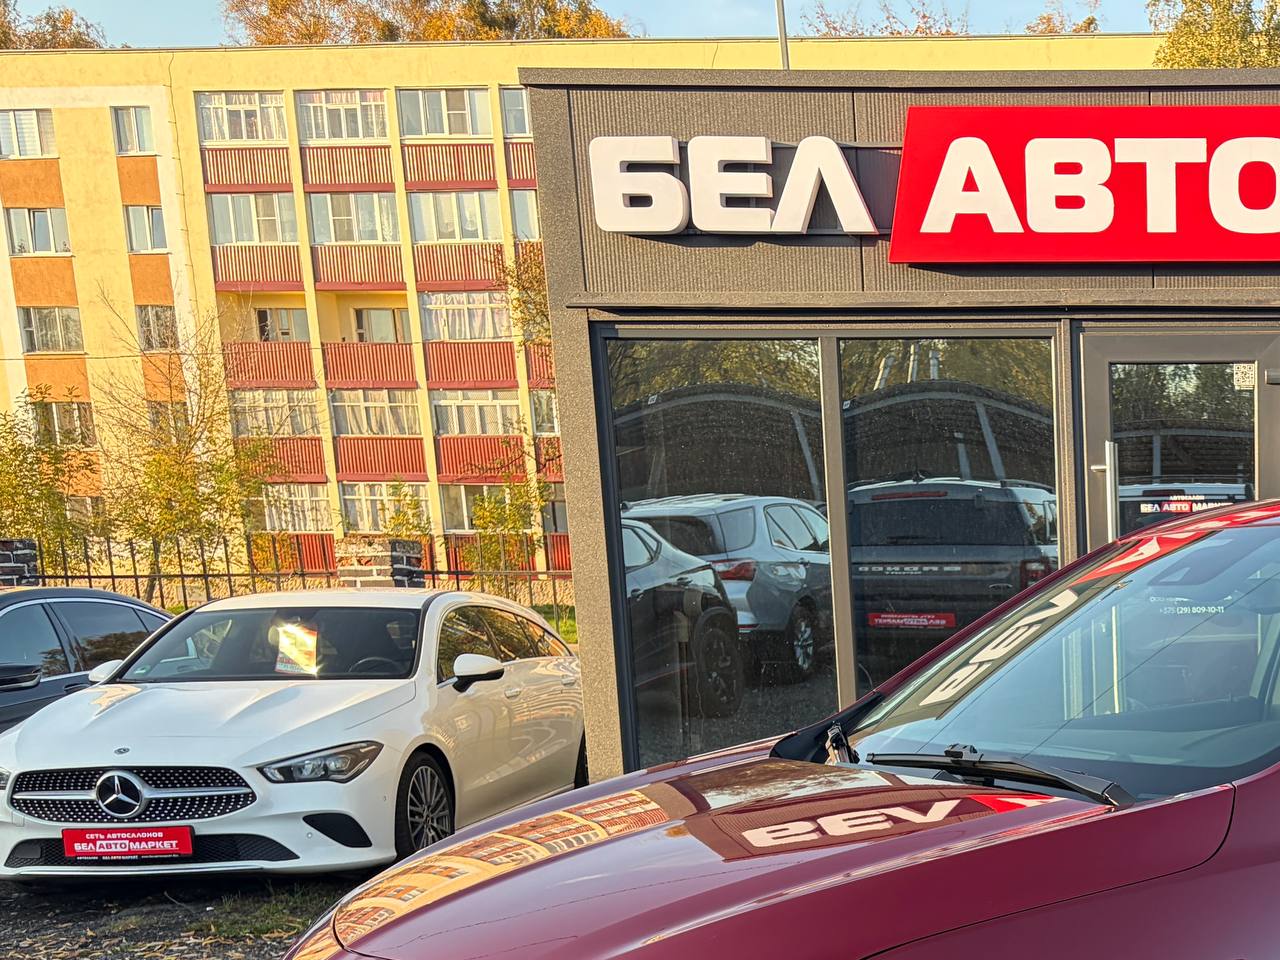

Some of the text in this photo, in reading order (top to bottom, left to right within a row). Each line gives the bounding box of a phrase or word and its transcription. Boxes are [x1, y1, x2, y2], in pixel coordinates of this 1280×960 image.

[589, 135, 878, 235] БЕЛ
[1140, 503, 1161, 513] БЕЛ
[1162, 503, 1190, 511] АВТО
[1176, 606, 1191, 614] (29)
[1192, 606, 1224, 614] 809-10-11
[86, 831, 164, 840] СЕТЬ АВТОСАЛОНОВ
[74, 840, 178, 851] БЕЛ АВТО МАРКЕТ
